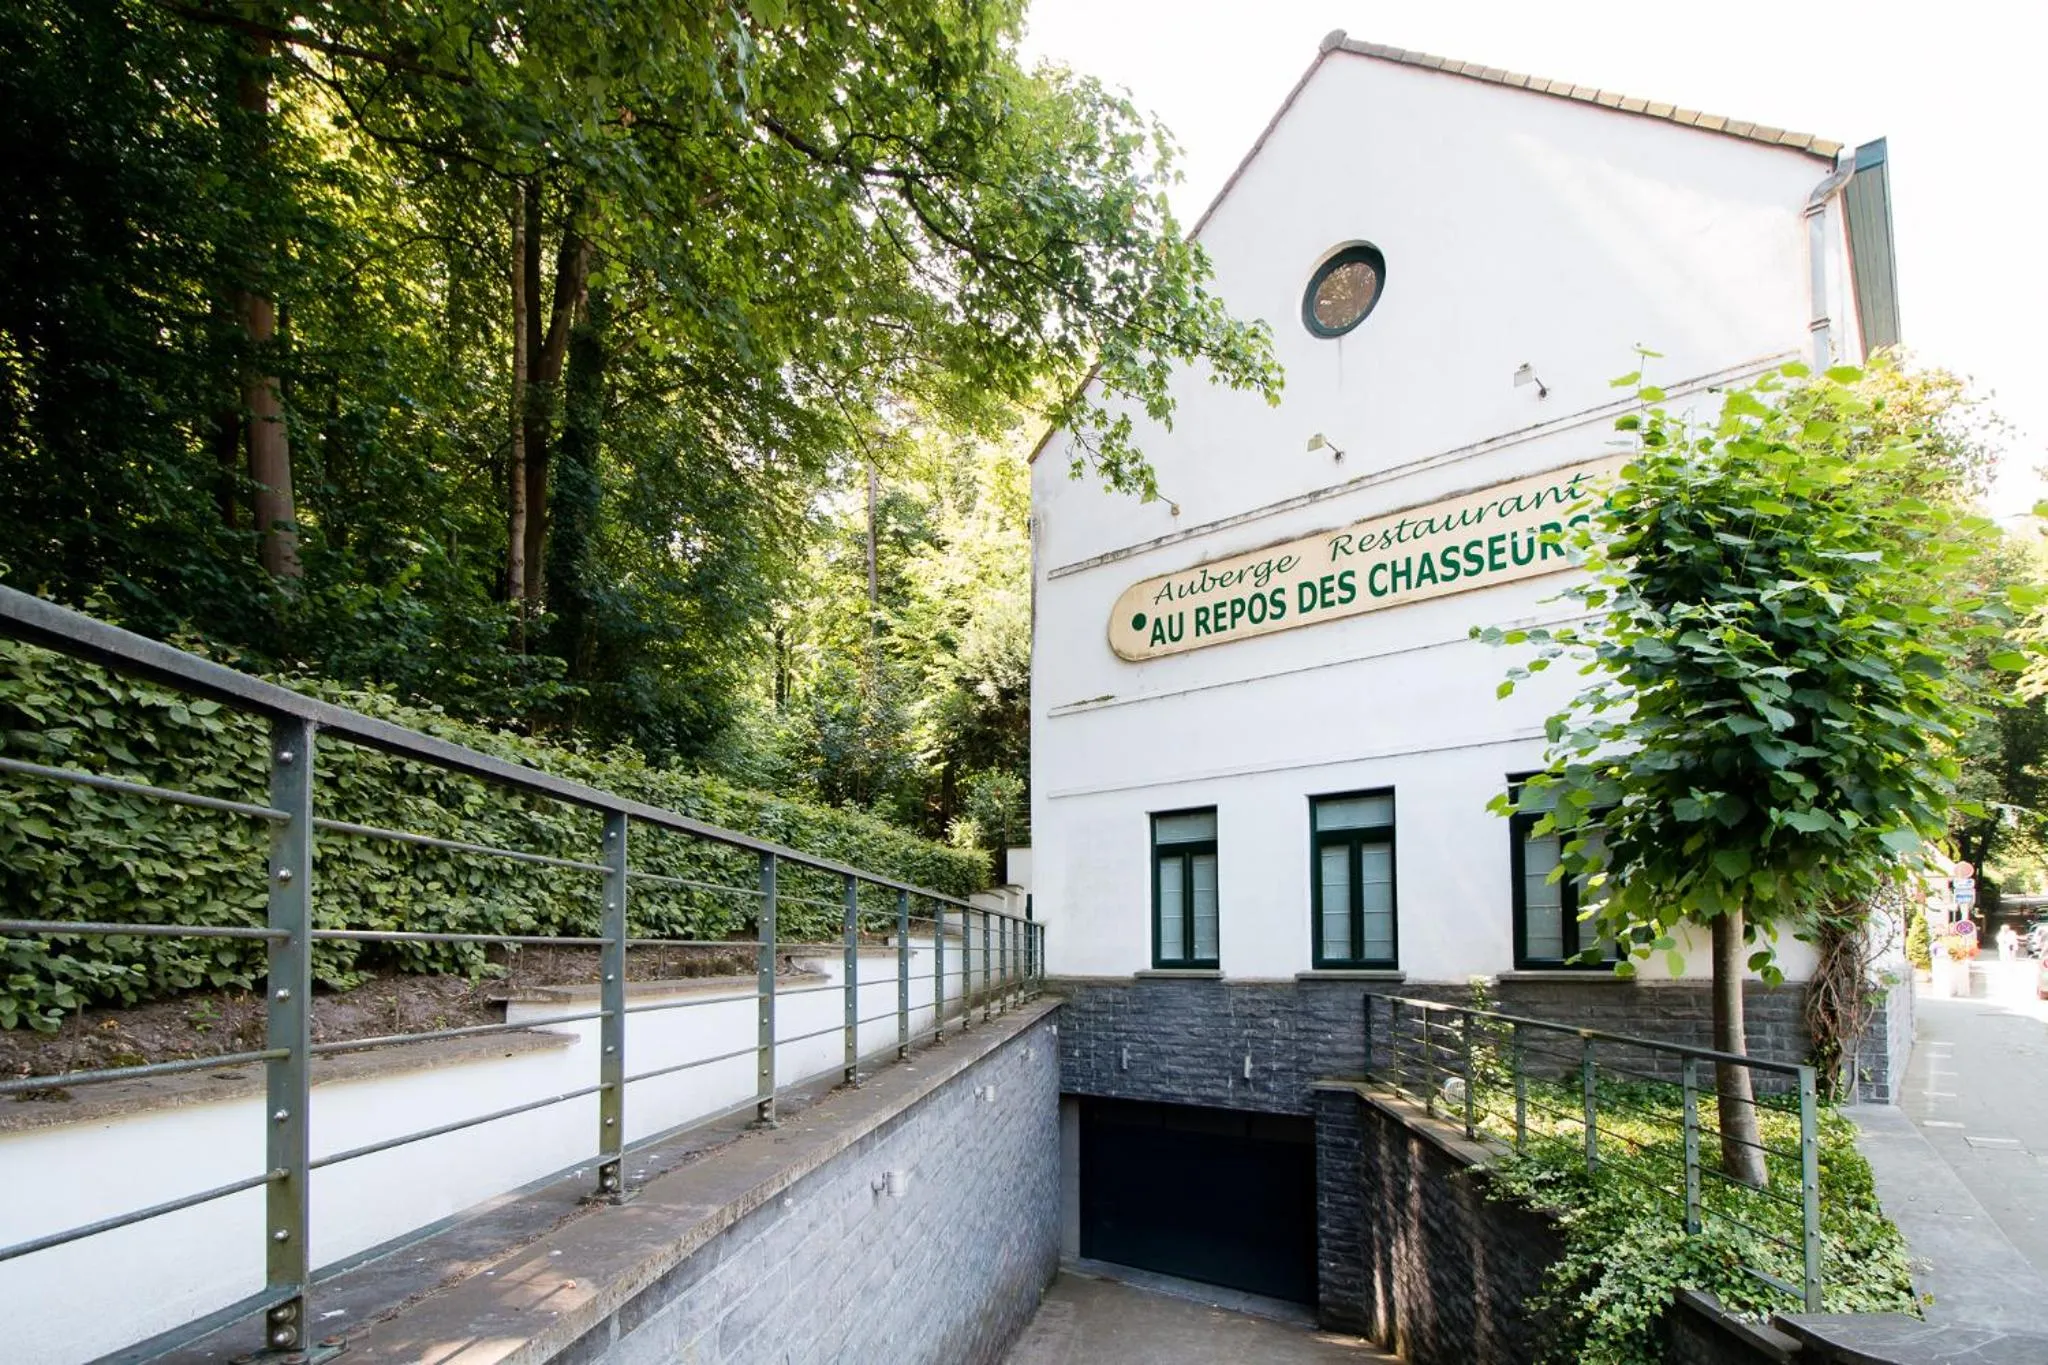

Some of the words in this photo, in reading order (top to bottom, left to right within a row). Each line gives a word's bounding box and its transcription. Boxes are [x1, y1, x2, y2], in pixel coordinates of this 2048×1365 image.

[1153, 554, 1301, 606] Auberge
[1328, 472, 1595, 562] Restaurant
[1150, 611, 1184, 647] AU
[1194, 587, 1287, 638] REPOS
[1298, 570, 1357, 615] DES
